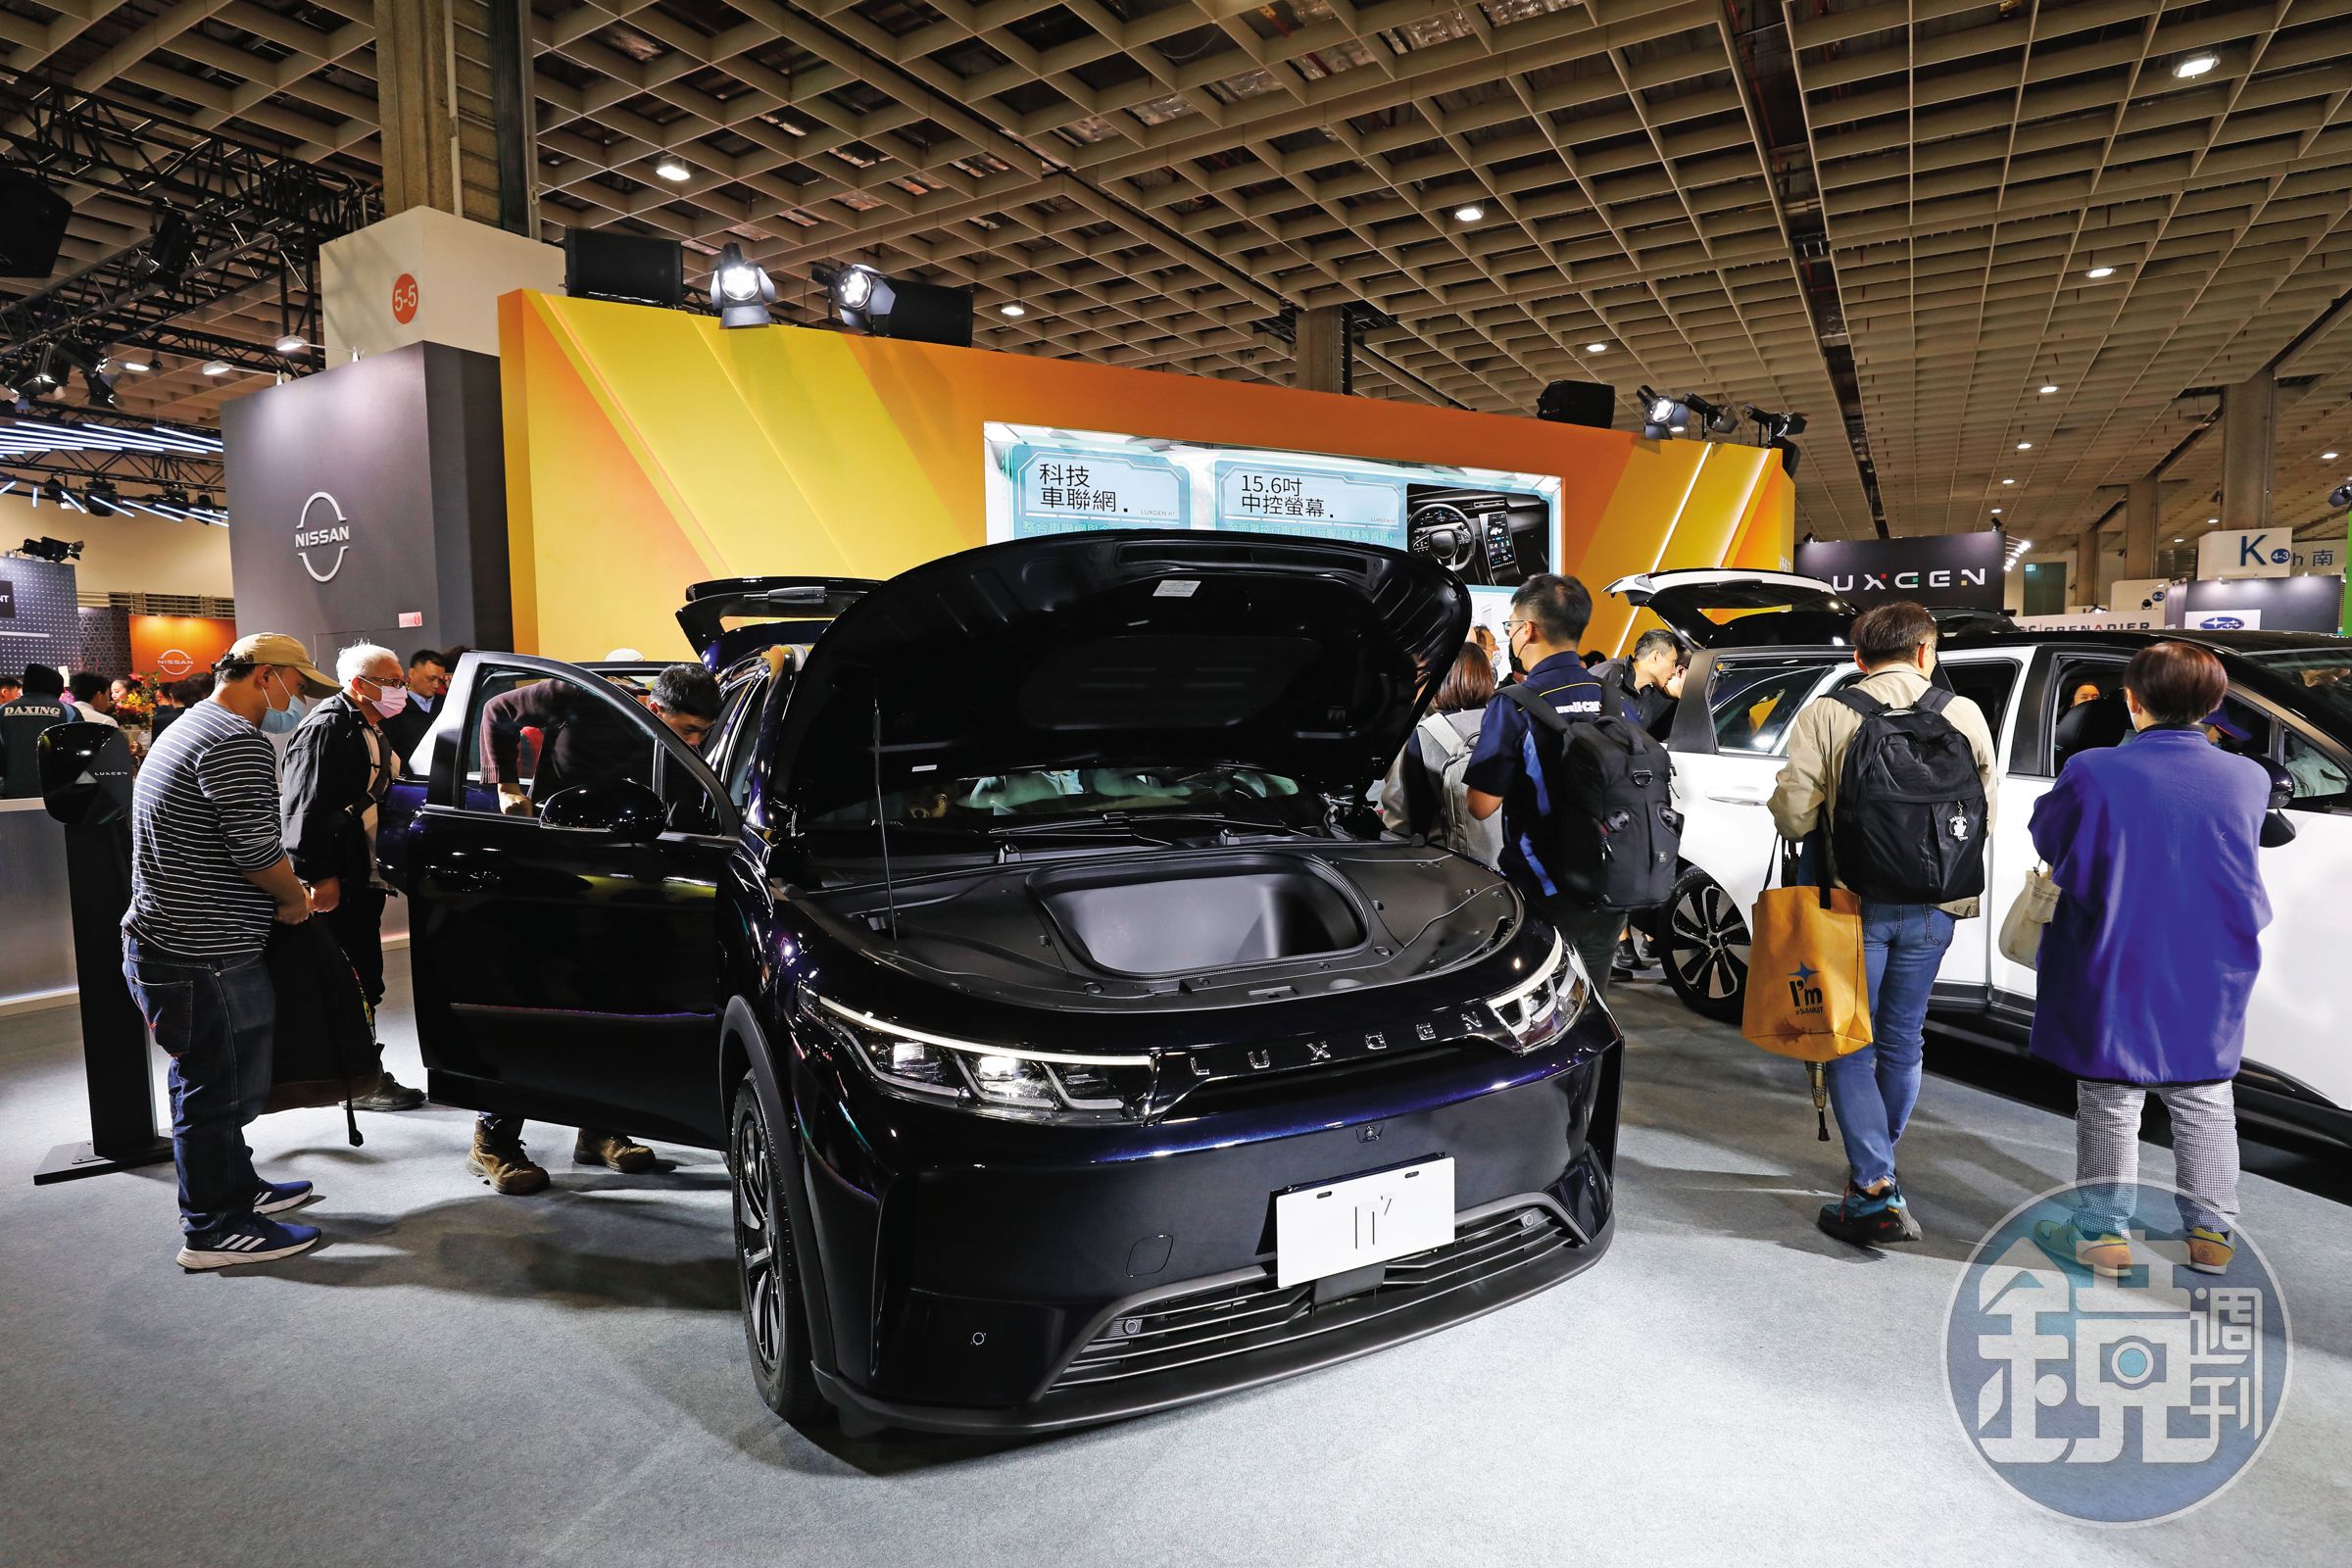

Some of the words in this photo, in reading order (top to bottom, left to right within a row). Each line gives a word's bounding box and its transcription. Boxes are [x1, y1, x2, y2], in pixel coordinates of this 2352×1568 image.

[395, 284, 416, 311] 5-5
[1039, 464, 1090, 487] 科技
[1242, 475, 1302, 497] 15.6吋
[295, 525, 350, 548] NISSAN
[2240, 534, 2268, 566] K
[2313, 549, 2334, 566] 南
[1833, 567, 1986, 592] UXGEN
[4, 706, 61, 715] DAXING
[1788, 979, 1823, 1007] I'm
[1189, 1010, 1483, 1076] LUXGEN
